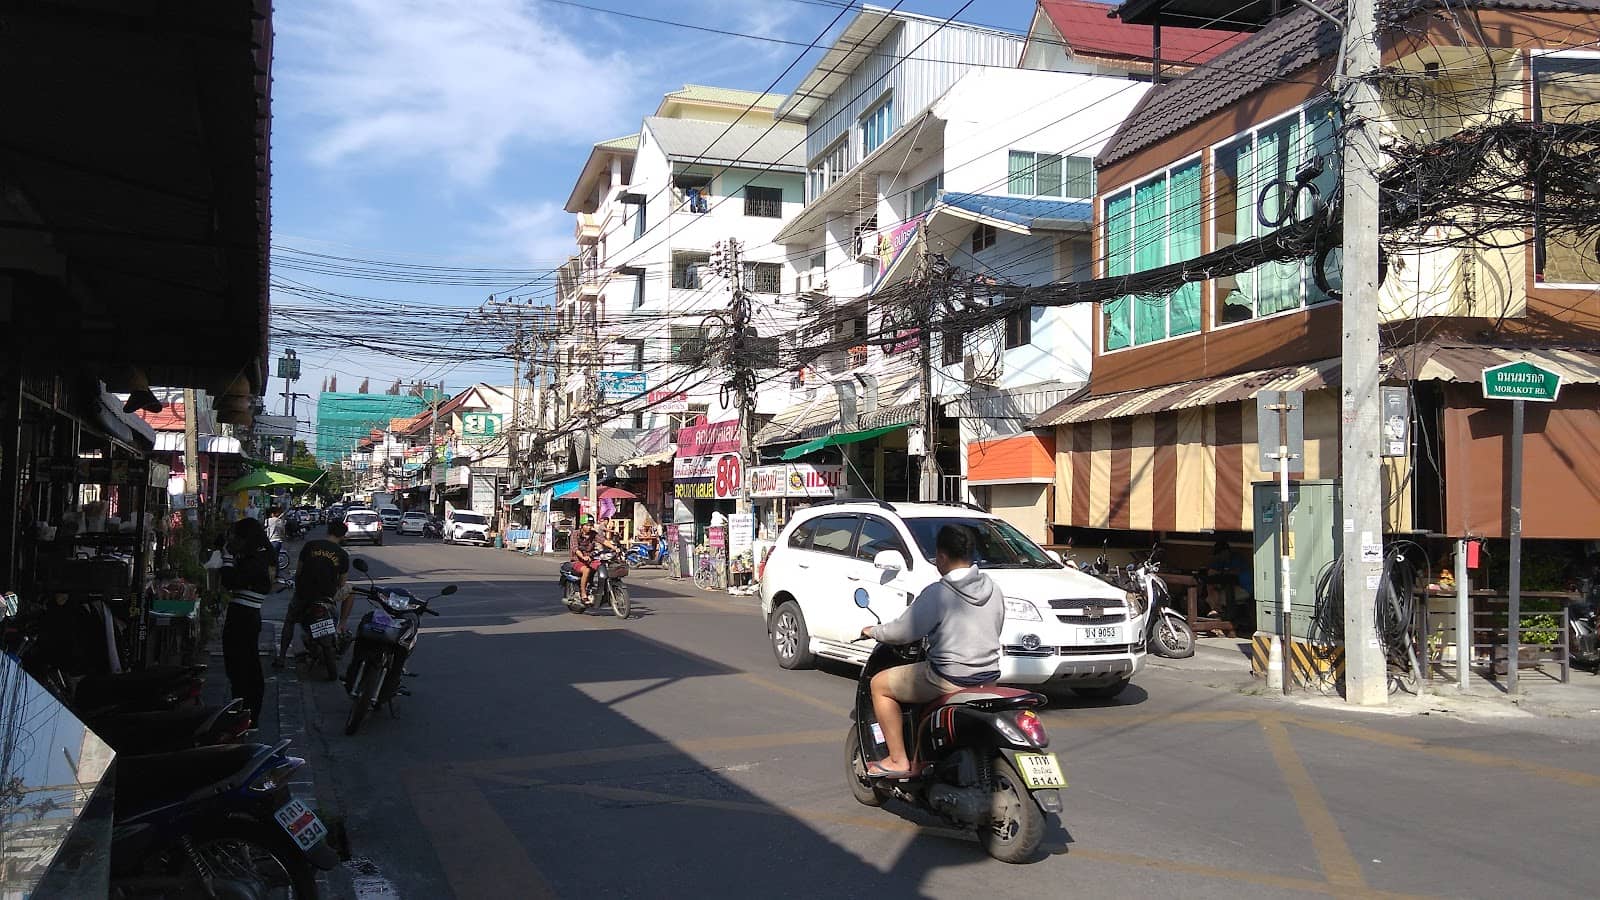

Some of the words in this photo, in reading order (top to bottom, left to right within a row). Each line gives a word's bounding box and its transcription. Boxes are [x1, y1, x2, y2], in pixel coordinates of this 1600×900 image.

[1497, 372, 1544, 383] ถนนมรกต
[1494, 385, 1535, 394] MORAKOT
[1535, 387, 1548, 395] RD.
[464, 414, 502, 434] ยา
[716, 456, 741, 497] 80
[1098, 627, 1116, 638] 9053
[1033, 776, 1060, 785] 8141
